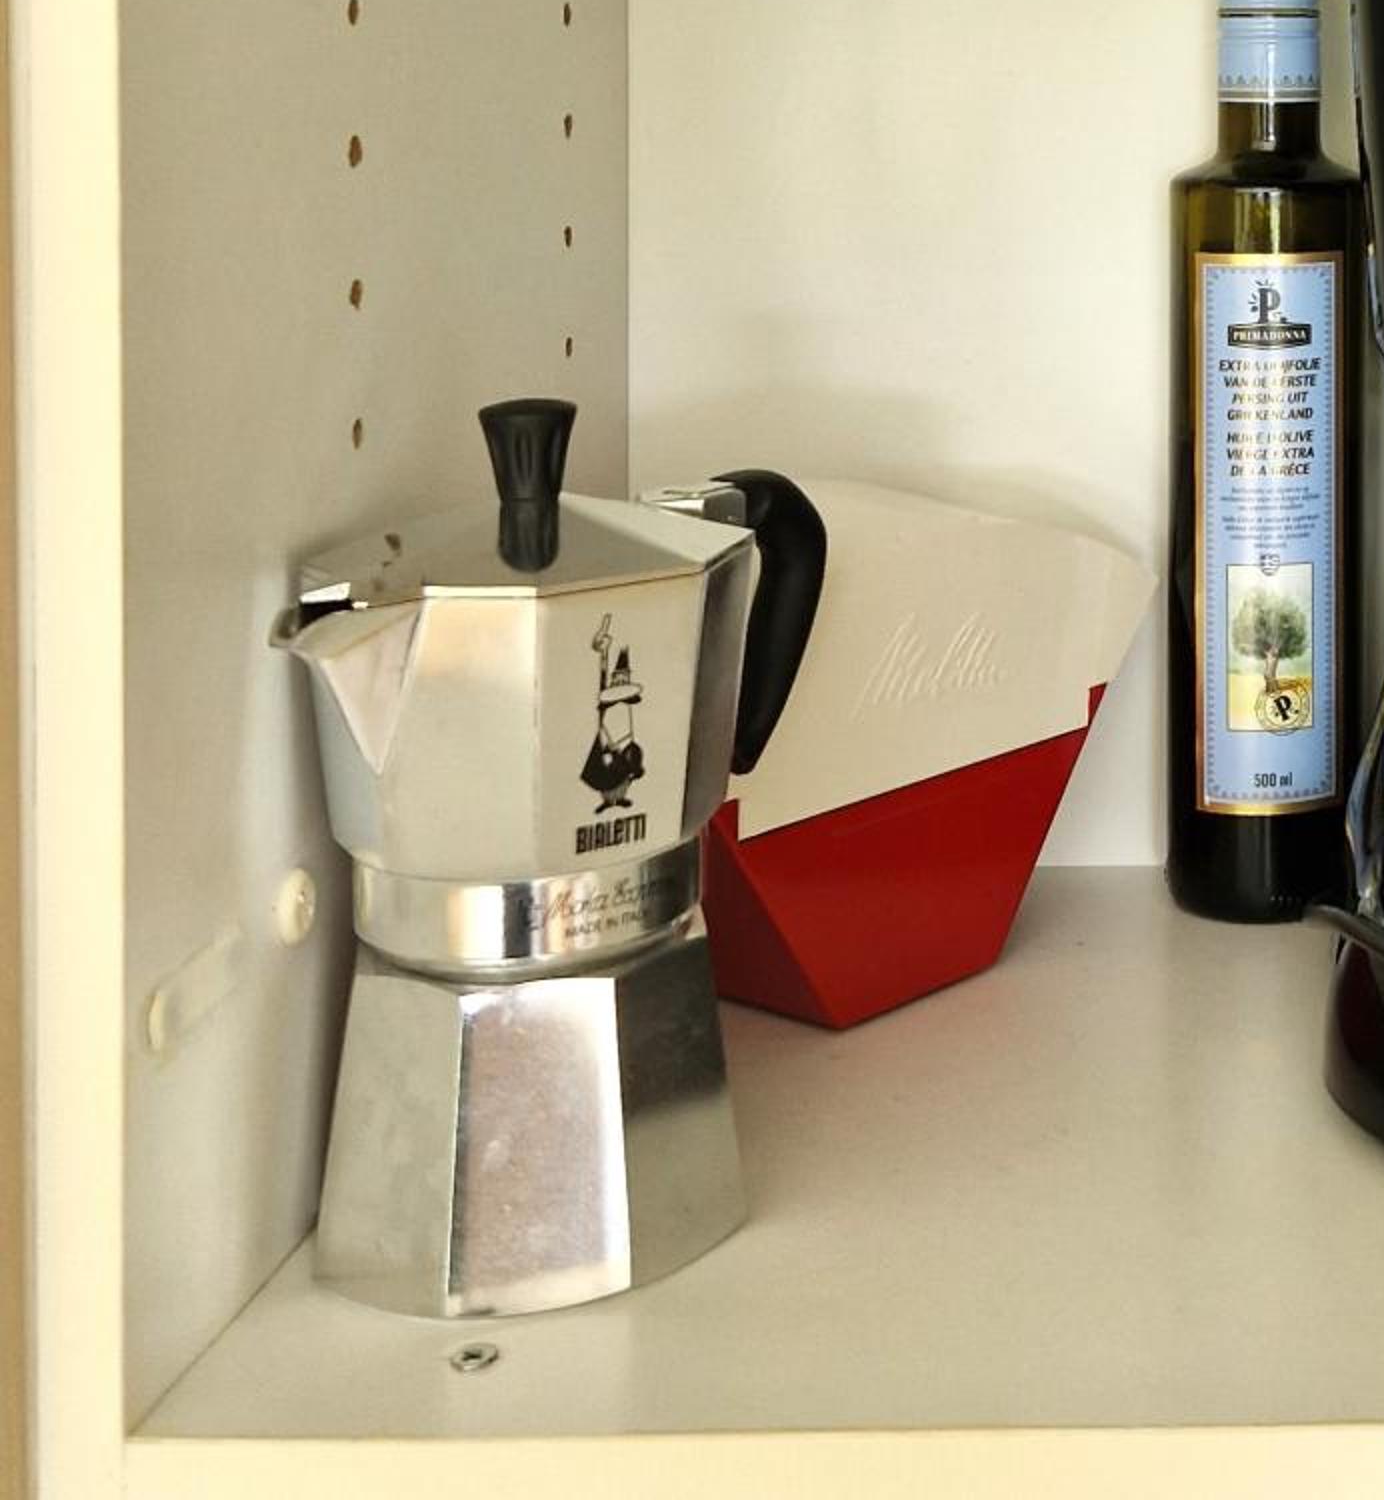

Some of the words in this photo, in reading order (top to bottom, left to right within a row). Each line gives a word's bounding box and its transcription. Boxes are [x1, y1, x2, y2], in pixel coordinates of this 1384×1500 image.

[1233, 328, 1307, 341] PRIMADONNA
[1287, 391, 1309, 405] UIT
[1253, 772, 1277, 789] 500
[1279, 771, 1294, 787] ml
[575, 813, 647, 854] BIALETTI
